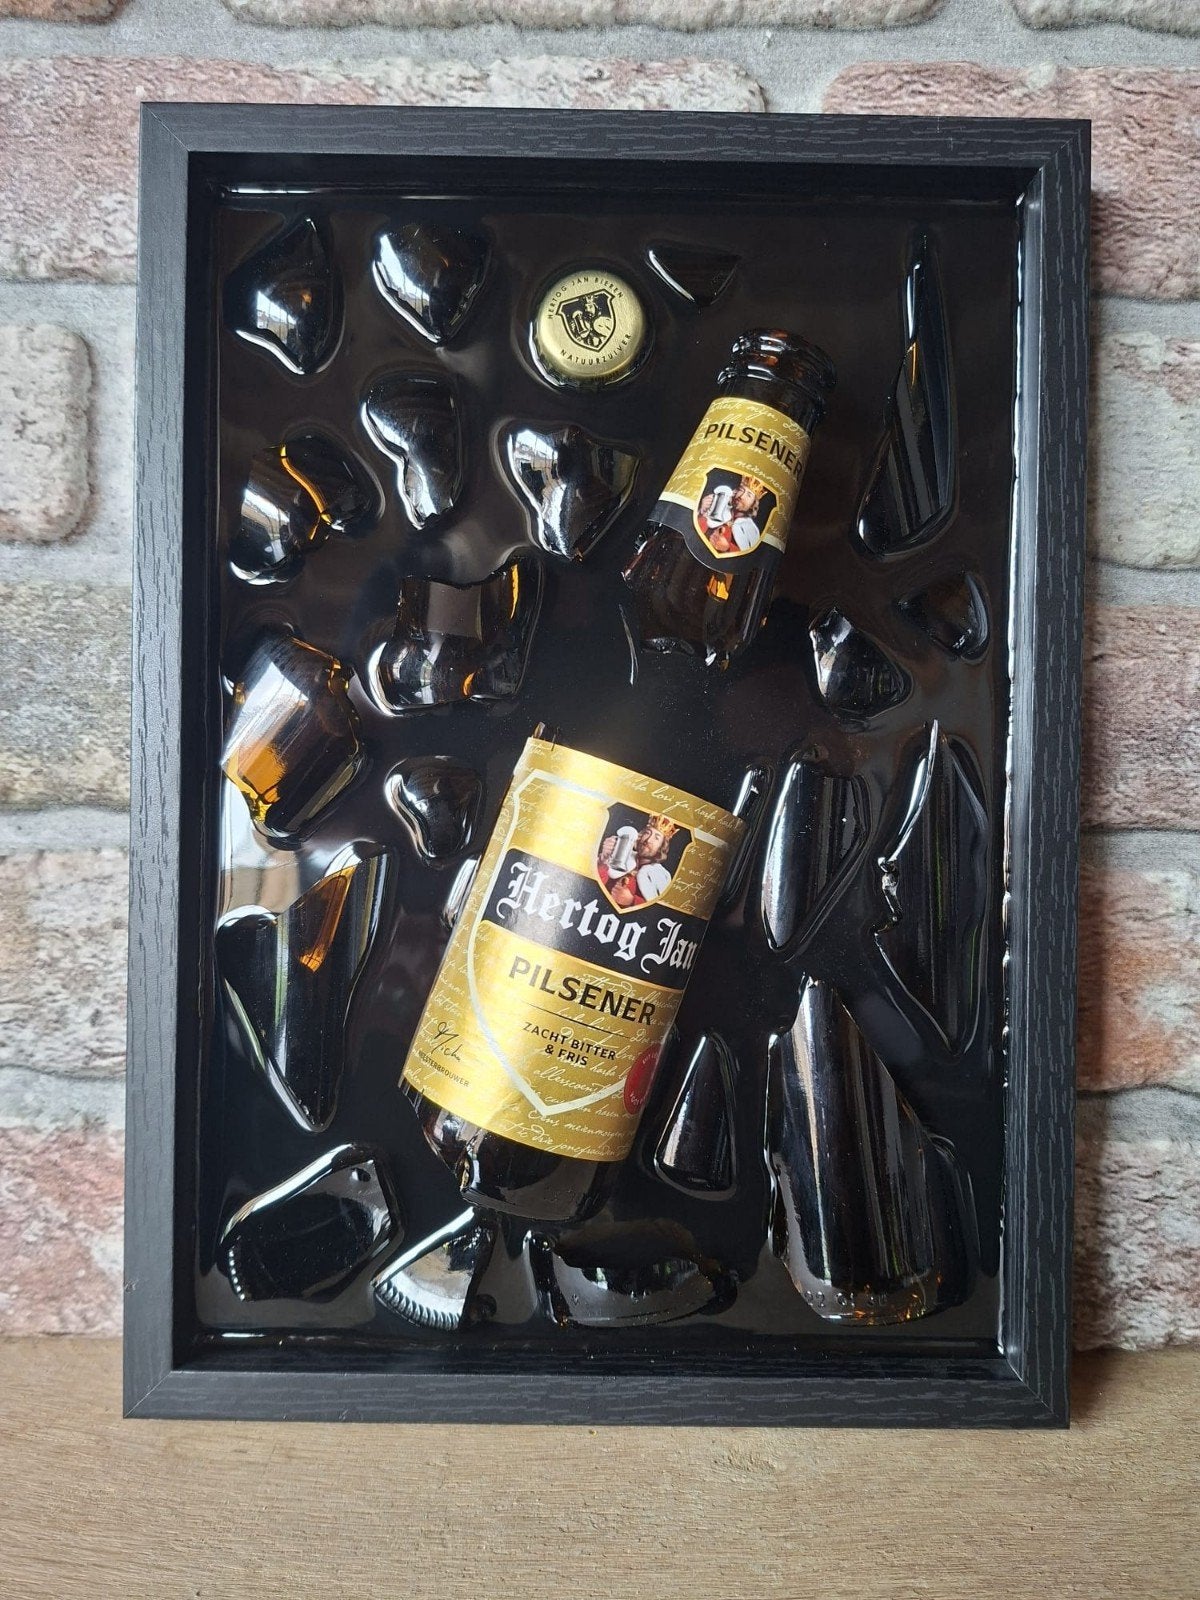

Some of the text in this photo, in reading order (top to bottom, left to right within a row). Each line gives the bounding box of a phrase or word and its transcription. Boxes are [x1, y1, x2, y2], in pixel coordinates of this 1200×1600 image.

[547, 277, 624, 320] HERTOG JAN BIEREN
[560, 333, 632, 366] NATUURZUIVER
[704, 423, 803, 482] PILSENER
[496, 861, 647, 962] Hertog
[640, 917, 698, 974] Jan
[508, 956, 657, 1026] PILSENER
[522, 1021, 568, 1046] ZACHT
[569, 1031, 617, 1061] BITTER
[544, 1043, 589, 1067] & FRIS
